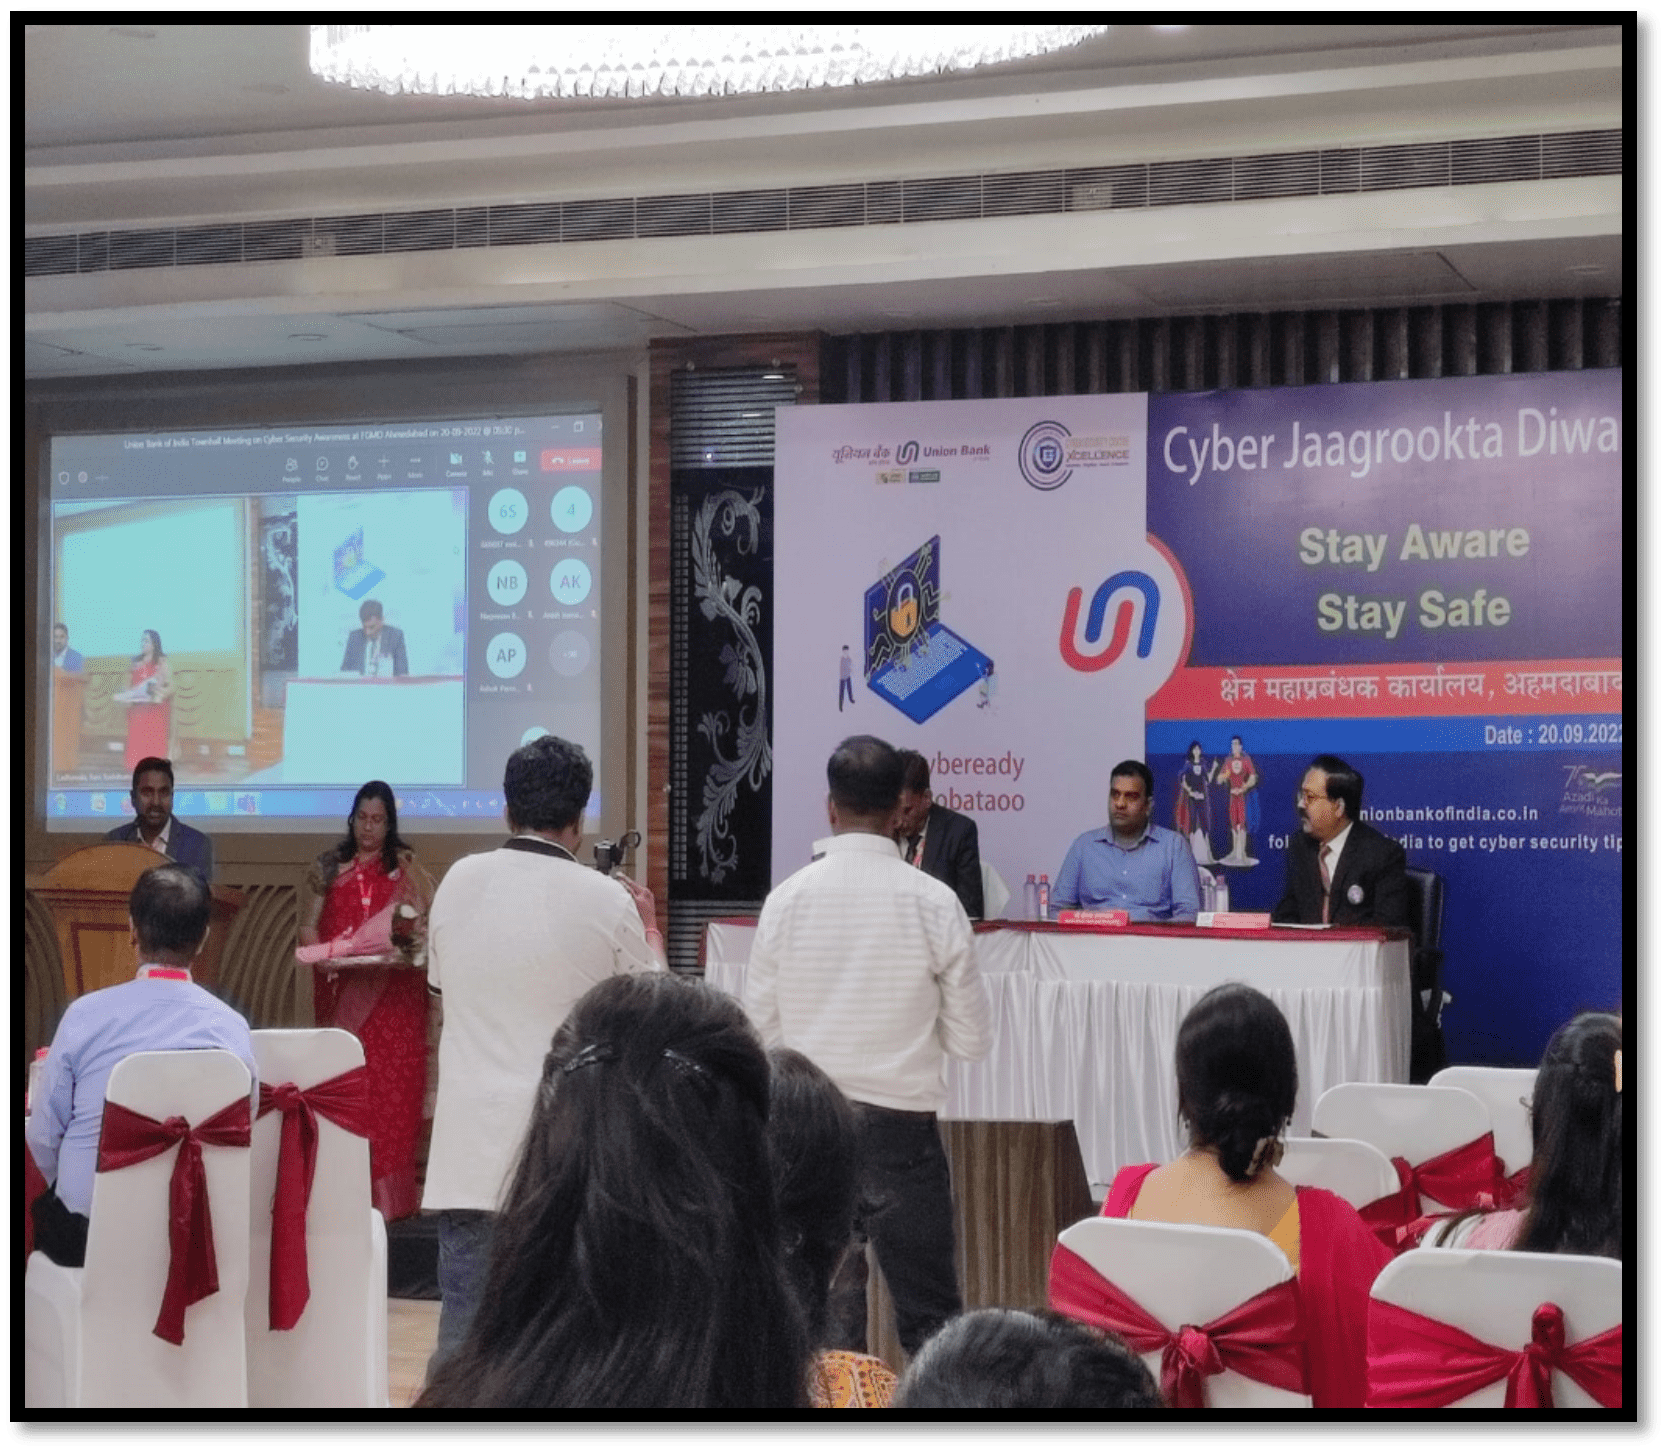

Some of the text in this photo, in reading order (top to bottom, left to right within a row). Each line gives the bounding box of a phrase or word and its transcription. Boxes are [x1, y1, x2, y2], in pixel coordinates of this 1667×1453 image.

[124, 439, 144, 449] Union
[146, 438, 163, 448] Bank
[164, 438, 171, 448] of
[172, 438, 189, 447] India
[223, 435, 251, 446] Meeting
[253, 436, 262, 445] on
[263, 434, 283, 445] Cyber
[285, 433, 312, 444] Security
[429, 430, 439, 438] on
[1163, 407, 1622, 486] Cyber Jaagrookta Diwa
[832, 444, 871, 465] यूनियन
[923, 444, 990, 457] Union Bank
[566, 503, 575, 516] 4
[1299, 523, 1531, 572] Stay Aware
[496, 575, 519, 591] NB
[559, 574, 581, 590] AK
[1316, 588, 1511, 639] Stay Safe
[496, 647, 517, 663] AP
[1220, 667, 1258, 707] क्षेत्र
[1263, 669, 1381, 705] महाप्रबंधक
[1485, 724, 1523, 745] Date
[935, 786, 1025, 812] obataoo
[1359, 805, 1539, 822] nionbankofindia.co.in
[1586, 805, 1622, 817] Mahot
[1268, 833, 1290, 849] fol
[1428, 834, 1444, 849] to
[1449, 835, 1475, 853] get
[1479, 834, 1526, 853] cyber
[1530, 833, 1598, 854] security
[1603, 833, 1622, 853] tip
